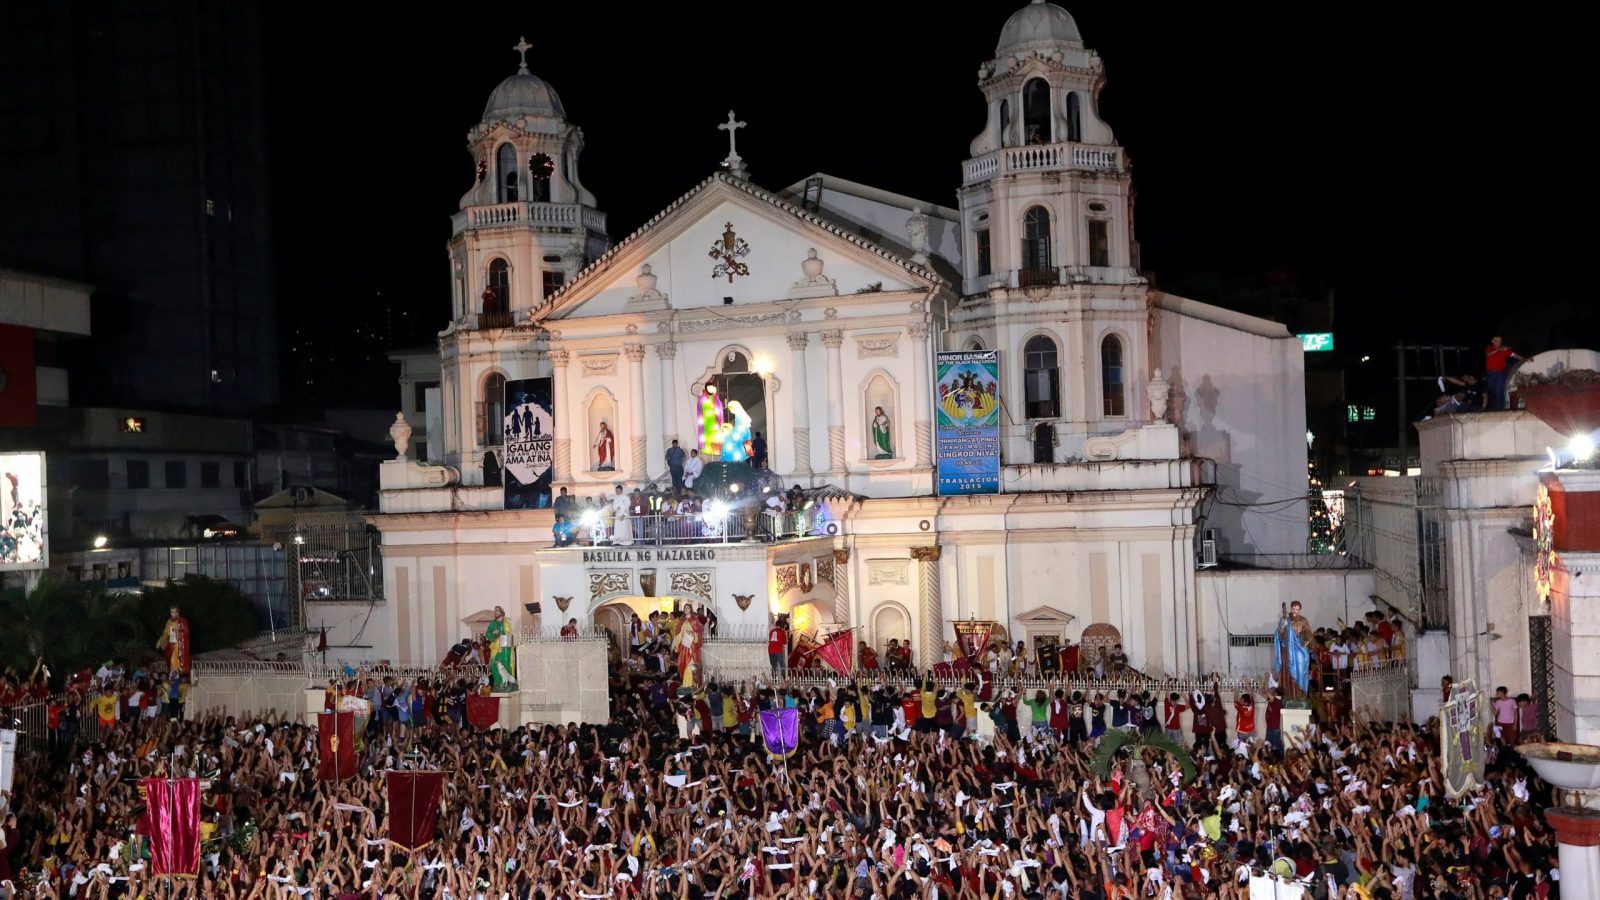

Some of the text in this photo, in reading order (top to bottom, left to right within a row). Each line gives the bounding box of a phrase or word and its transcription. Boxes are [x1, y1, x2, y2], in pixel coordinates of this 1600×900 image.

[507, 442, 551, 453] IGALANG
[506, 454, 552, 464] AMA AT INA
[583, 550, 715, 562] BASILIKA NG NAZARENO
